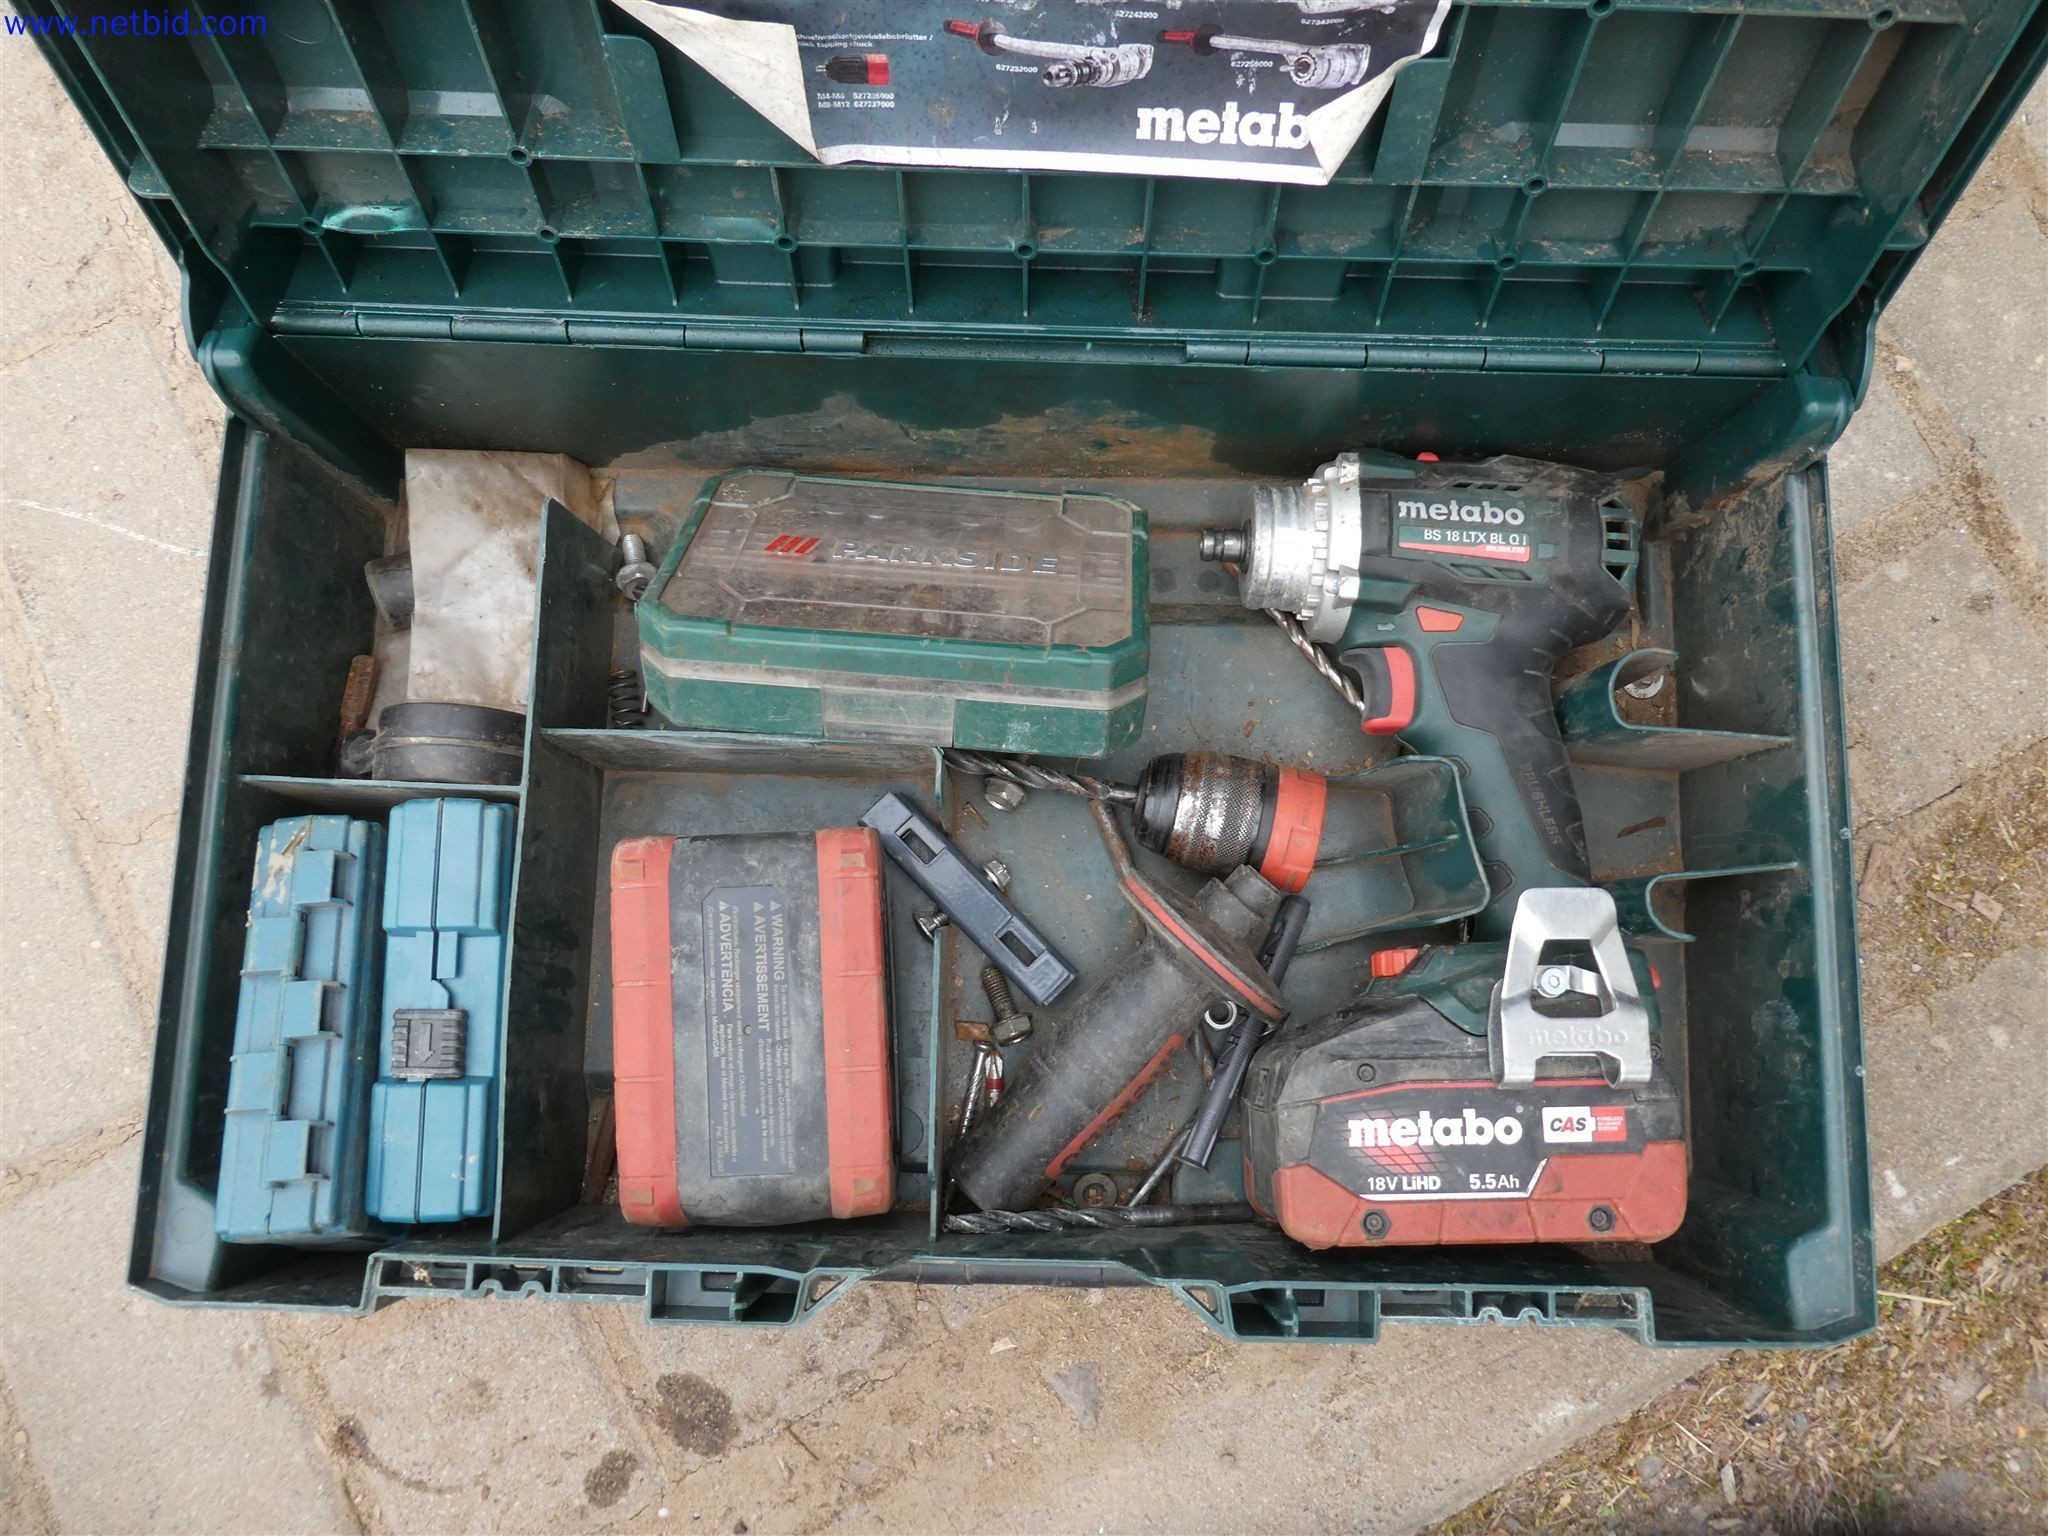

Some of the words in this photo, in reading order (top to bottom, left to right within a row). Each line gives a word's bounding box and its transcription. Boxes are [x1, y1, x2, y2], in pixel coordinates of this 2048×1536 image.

[1136, 101, 1311, 150] metab
[1398, 499, 1525, 526] metabo
[1424, 528, 1442, 541] BS
[1446, 530, 1460, 542] 18
[1462, 531, 1486, 544] LTX
[1489, 533, 1506, 545] BL
[1509, 533, 1520, 546] Q
[833, 539, 1059, 576] PARKSIDE
[719, 914, 734, 1012] ADVERTENCIA
[771, 914, 784, 980] WARNING
[754, 916, 769, 1031] AVERTISSEMENT
[1527, 1024, 1628, 1046] metabo
[1348, 1109, 1523, 1149] metabo
[1550, 1116, 1587, 1133] CAS
[1367, 1176, 1398, 1191] 18V
[1402, 1176, 1441, 1191] LiHD
[1469, 1175, 1520, 1190] 5.5Ah
